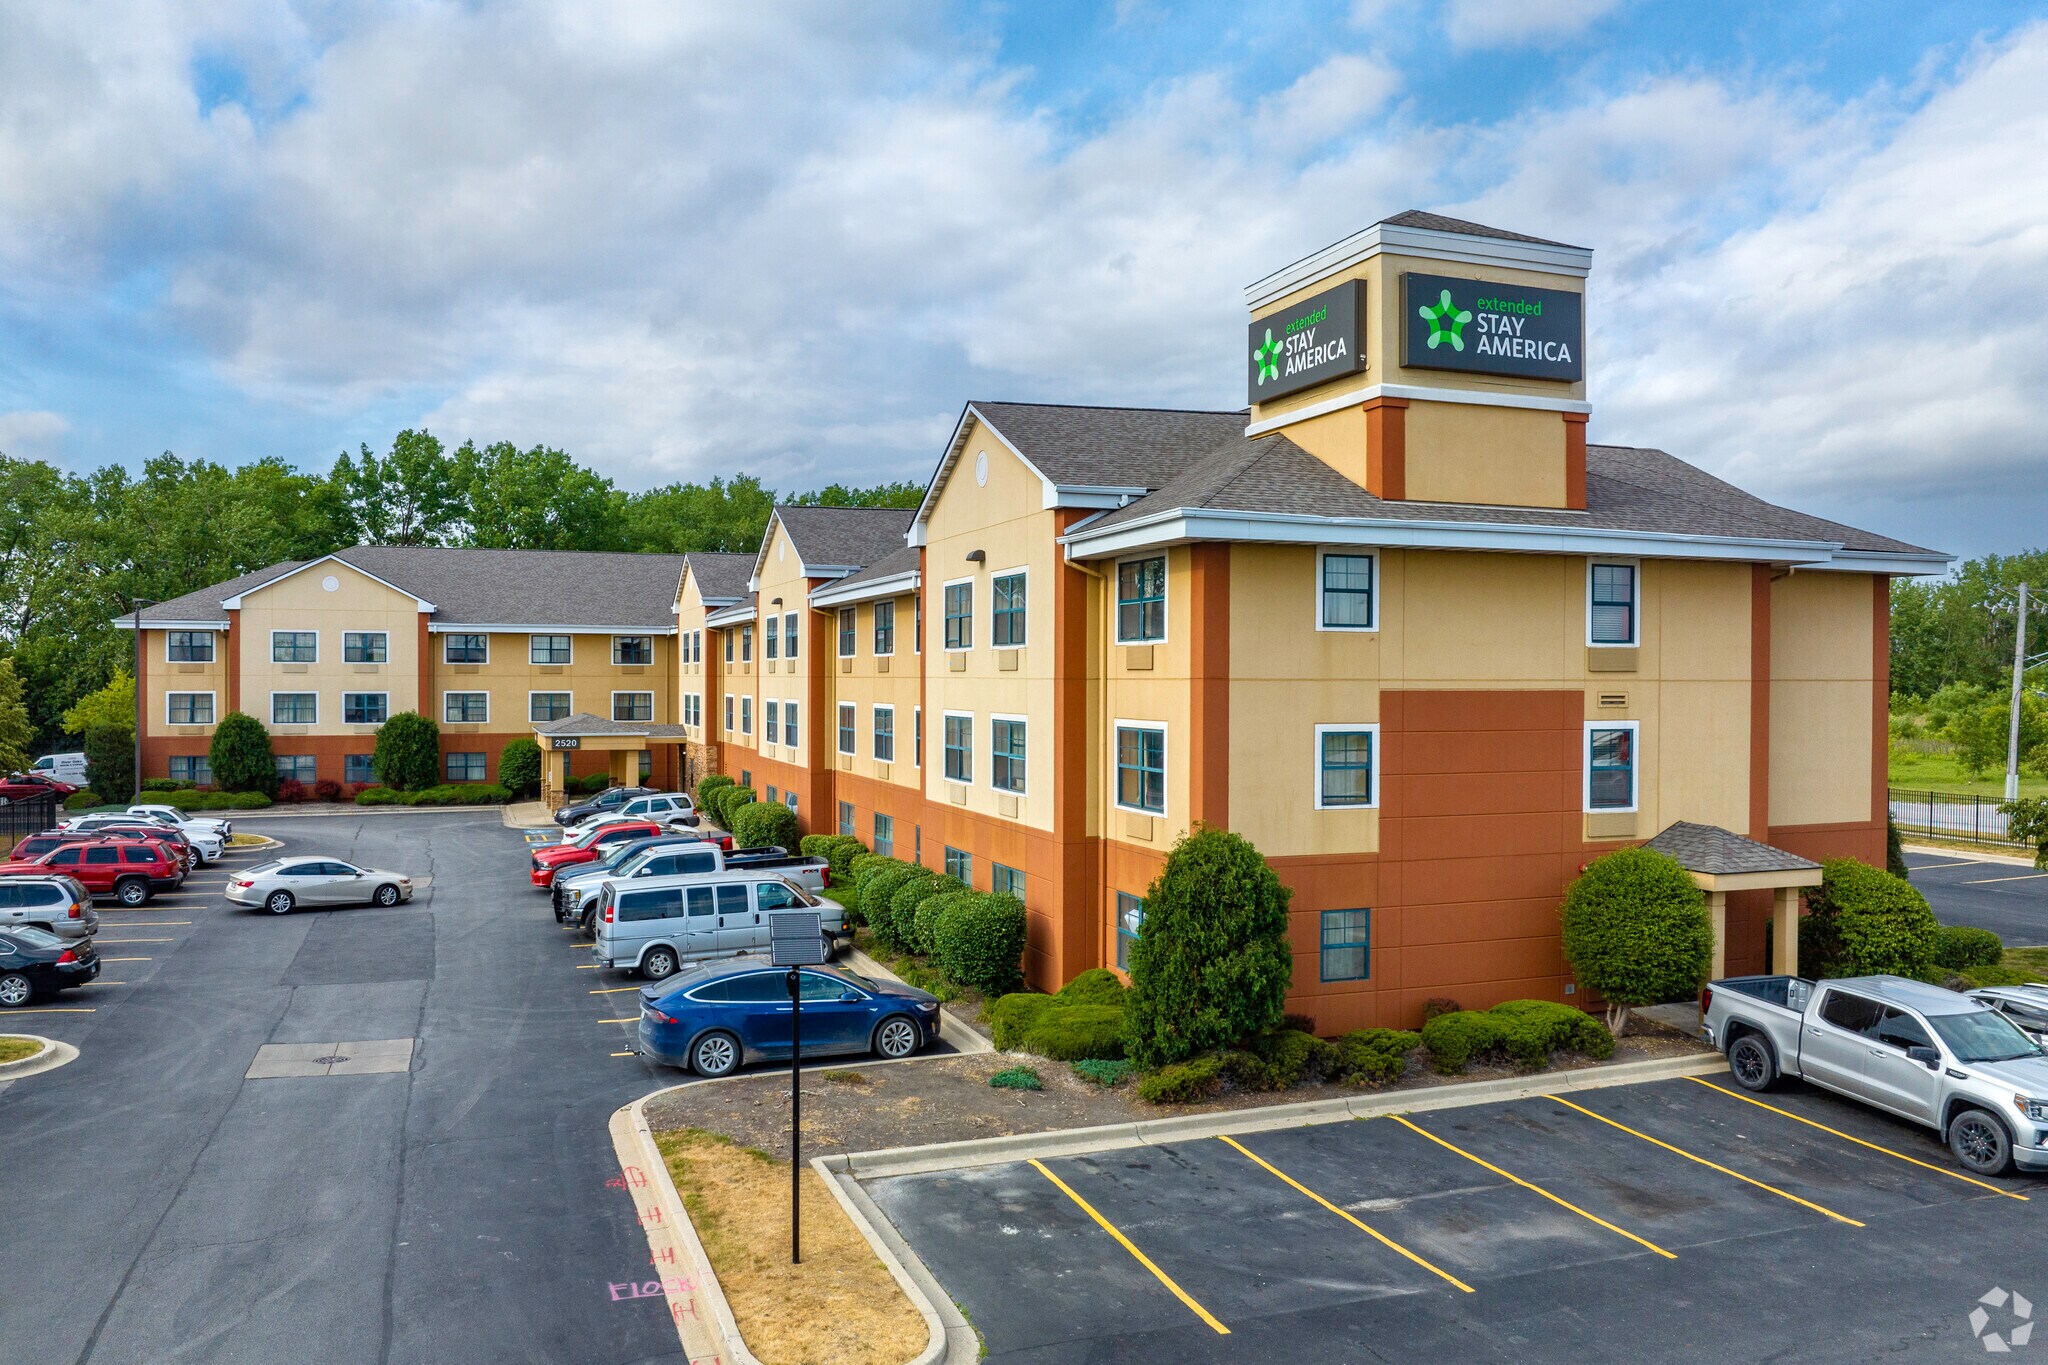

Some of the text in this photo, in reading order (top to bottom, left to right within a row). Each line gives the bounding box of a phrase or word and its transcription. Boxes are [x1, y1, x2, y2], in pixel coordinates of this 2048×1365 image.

[1285, 304, 1328, 334] extended
[1477, 298, 1542, 316] extended
[1477, 312, 1525, 336] STAY
[1285, 327, 1316, 356] STAY
[1476, 334, 1572, 363] AMERICA
[1285, 337, 1347, 377] AMERICA
[555, 739, 577, 747] 2520
